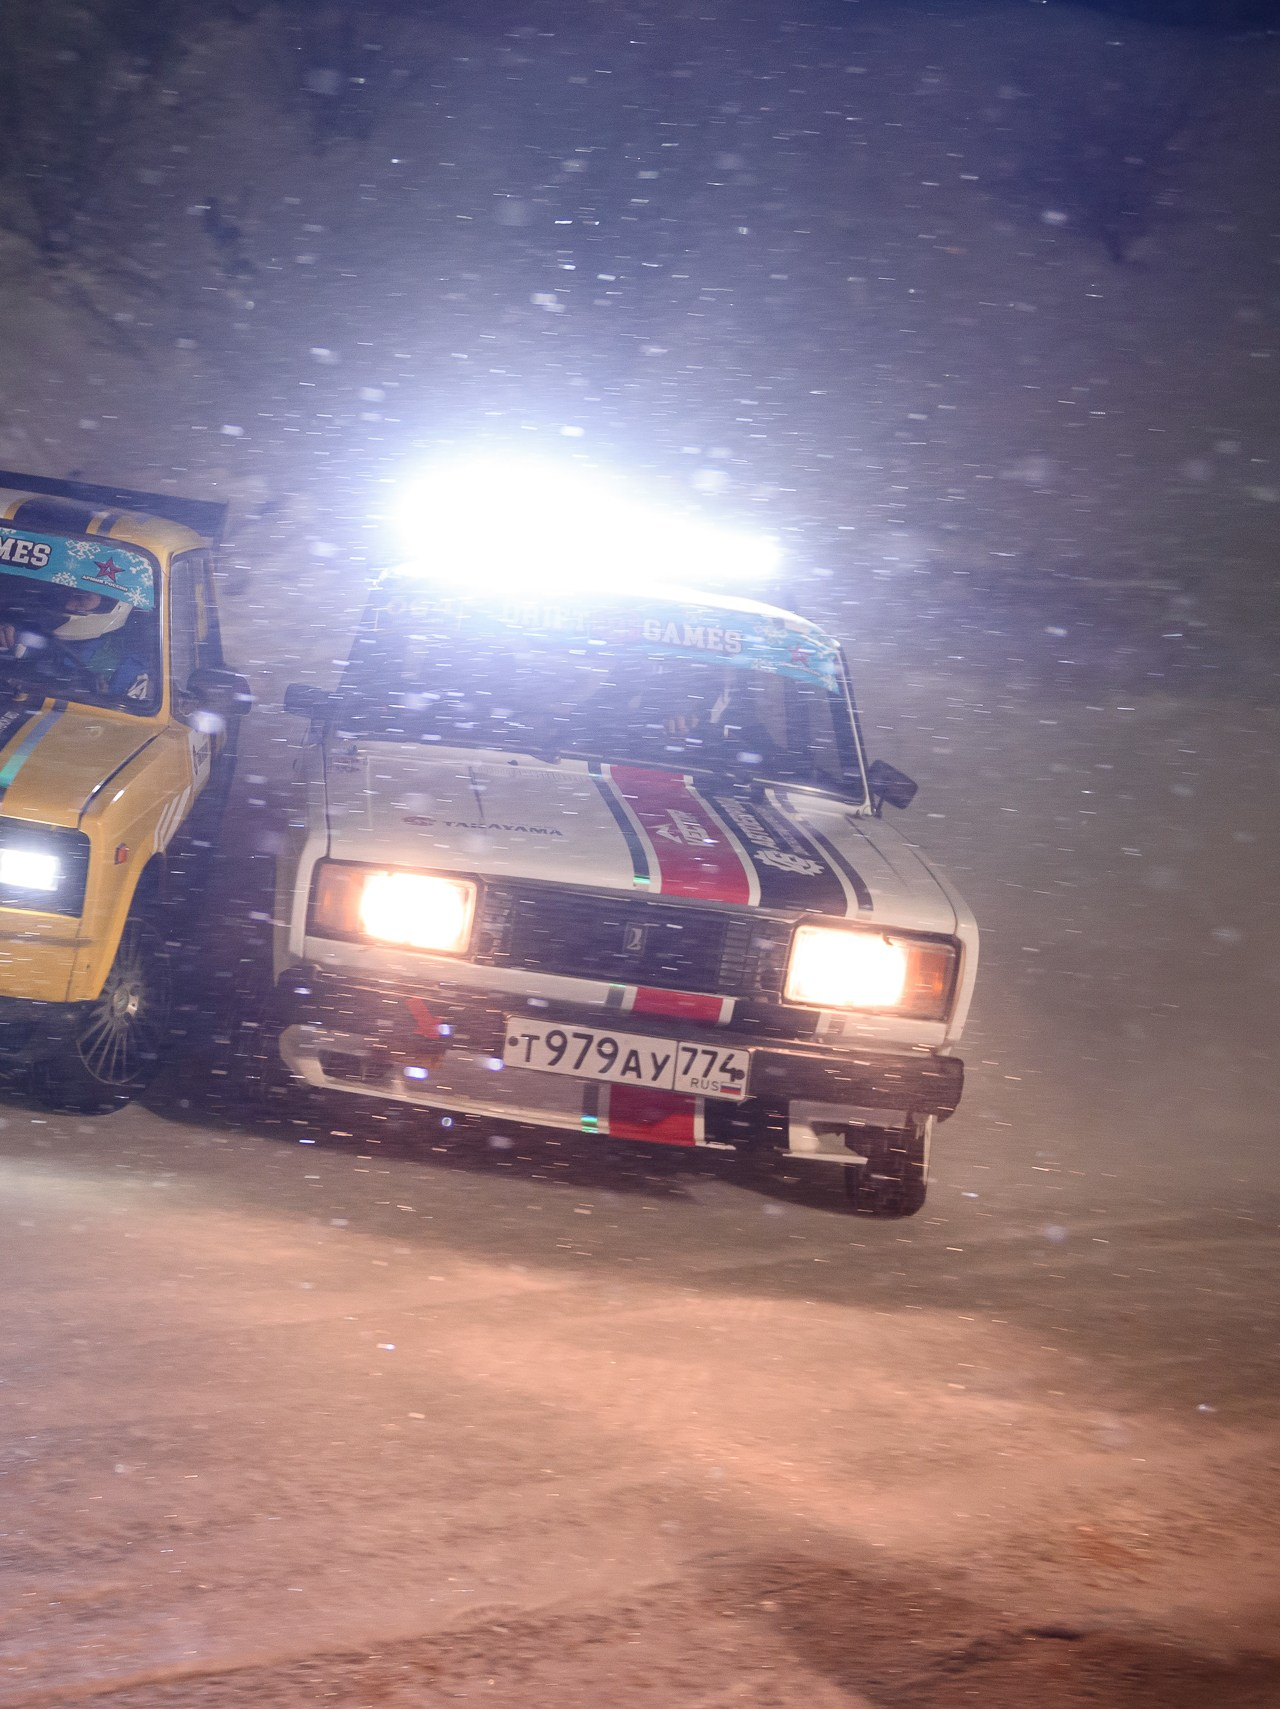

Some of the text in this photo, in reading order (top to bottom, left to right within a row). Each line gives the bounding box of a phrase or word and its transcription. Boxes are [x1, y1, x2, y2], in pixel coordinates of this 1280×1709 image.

[643, 619, 742, 654] GAMES
[681, 1046, 739, 1083] 774
[690, 1077, 719, 1092] RUS
